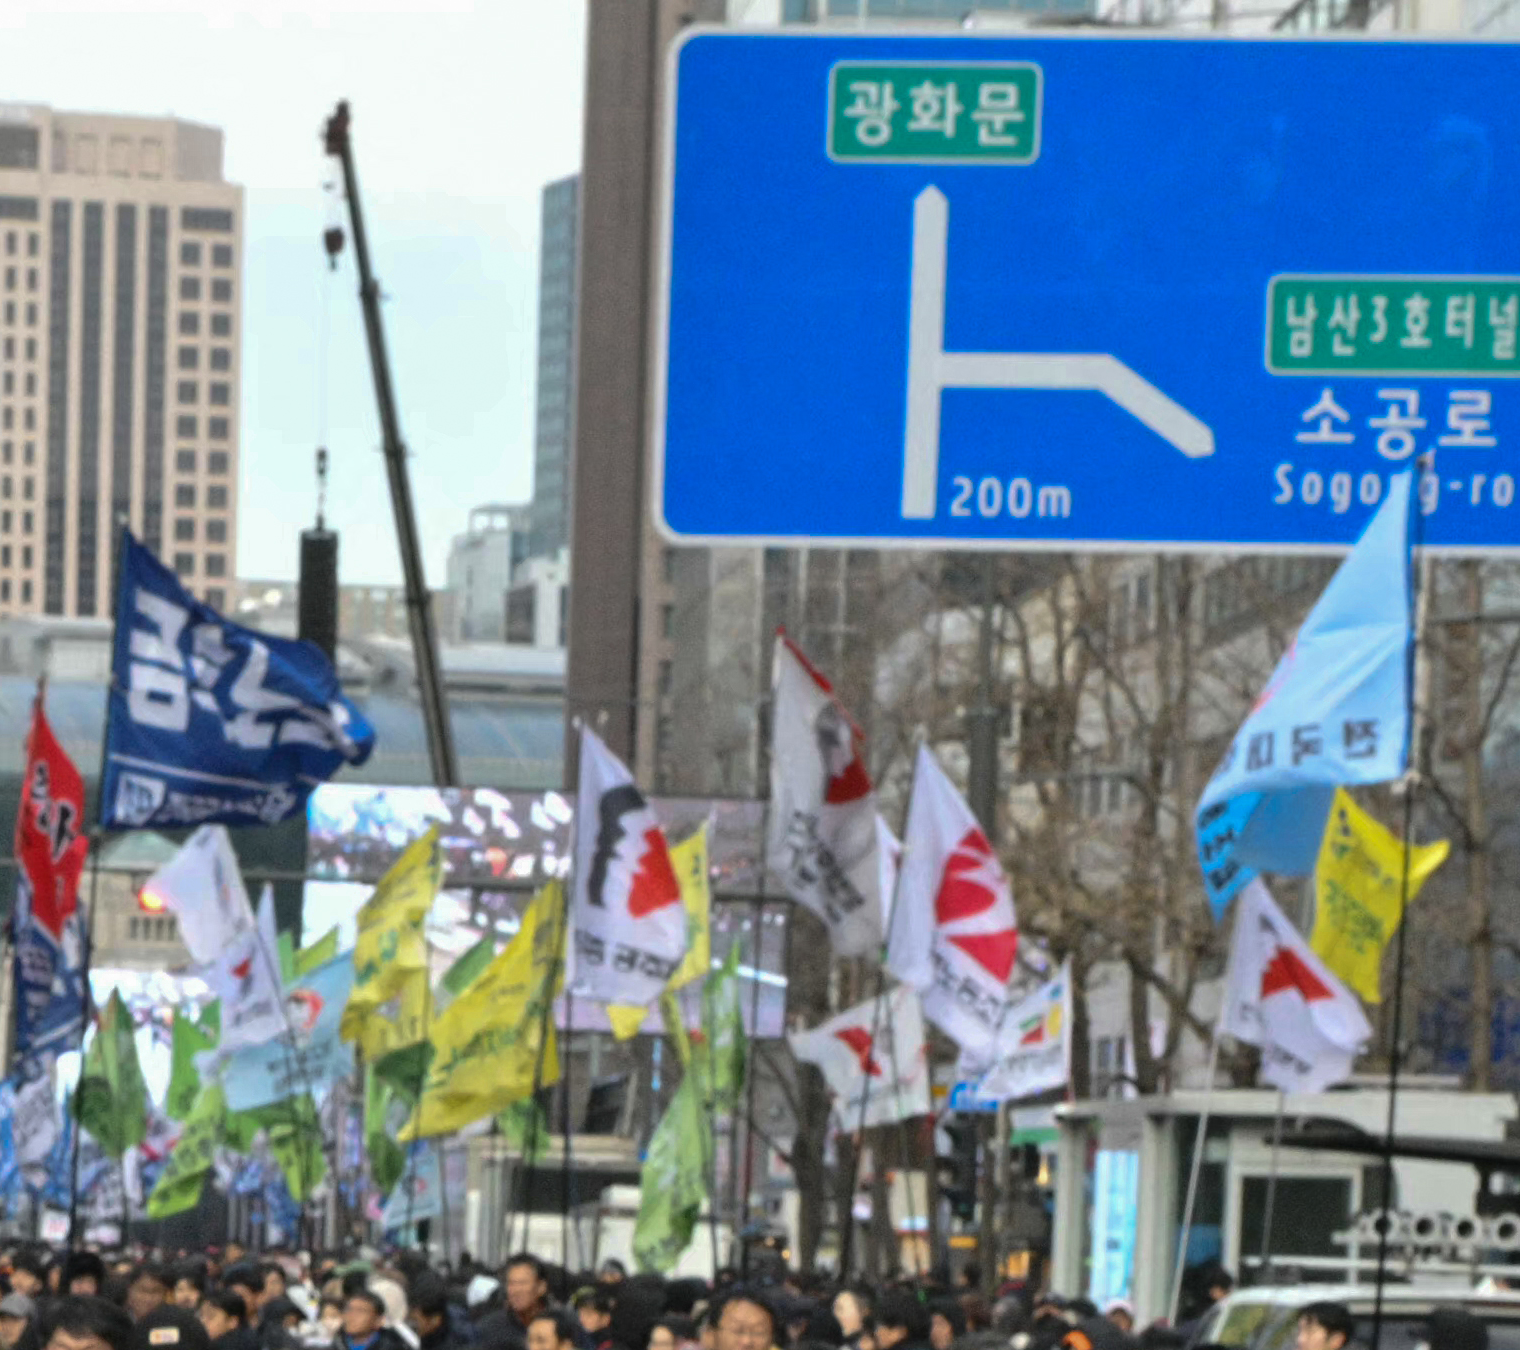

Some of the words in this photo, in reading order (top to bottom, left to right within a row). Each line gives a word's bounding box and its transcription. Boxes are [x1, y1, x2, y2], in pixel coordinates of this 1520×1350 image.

[842, 81, 1025, 148] 광화문
[1284, 292, 1519, 360] 남산3호터널
[1295, 389, 1496, 459] 소공로
[951, 475, 1071, 518] 200m
[1274, 463, 1515, 518] Sogog-ro
